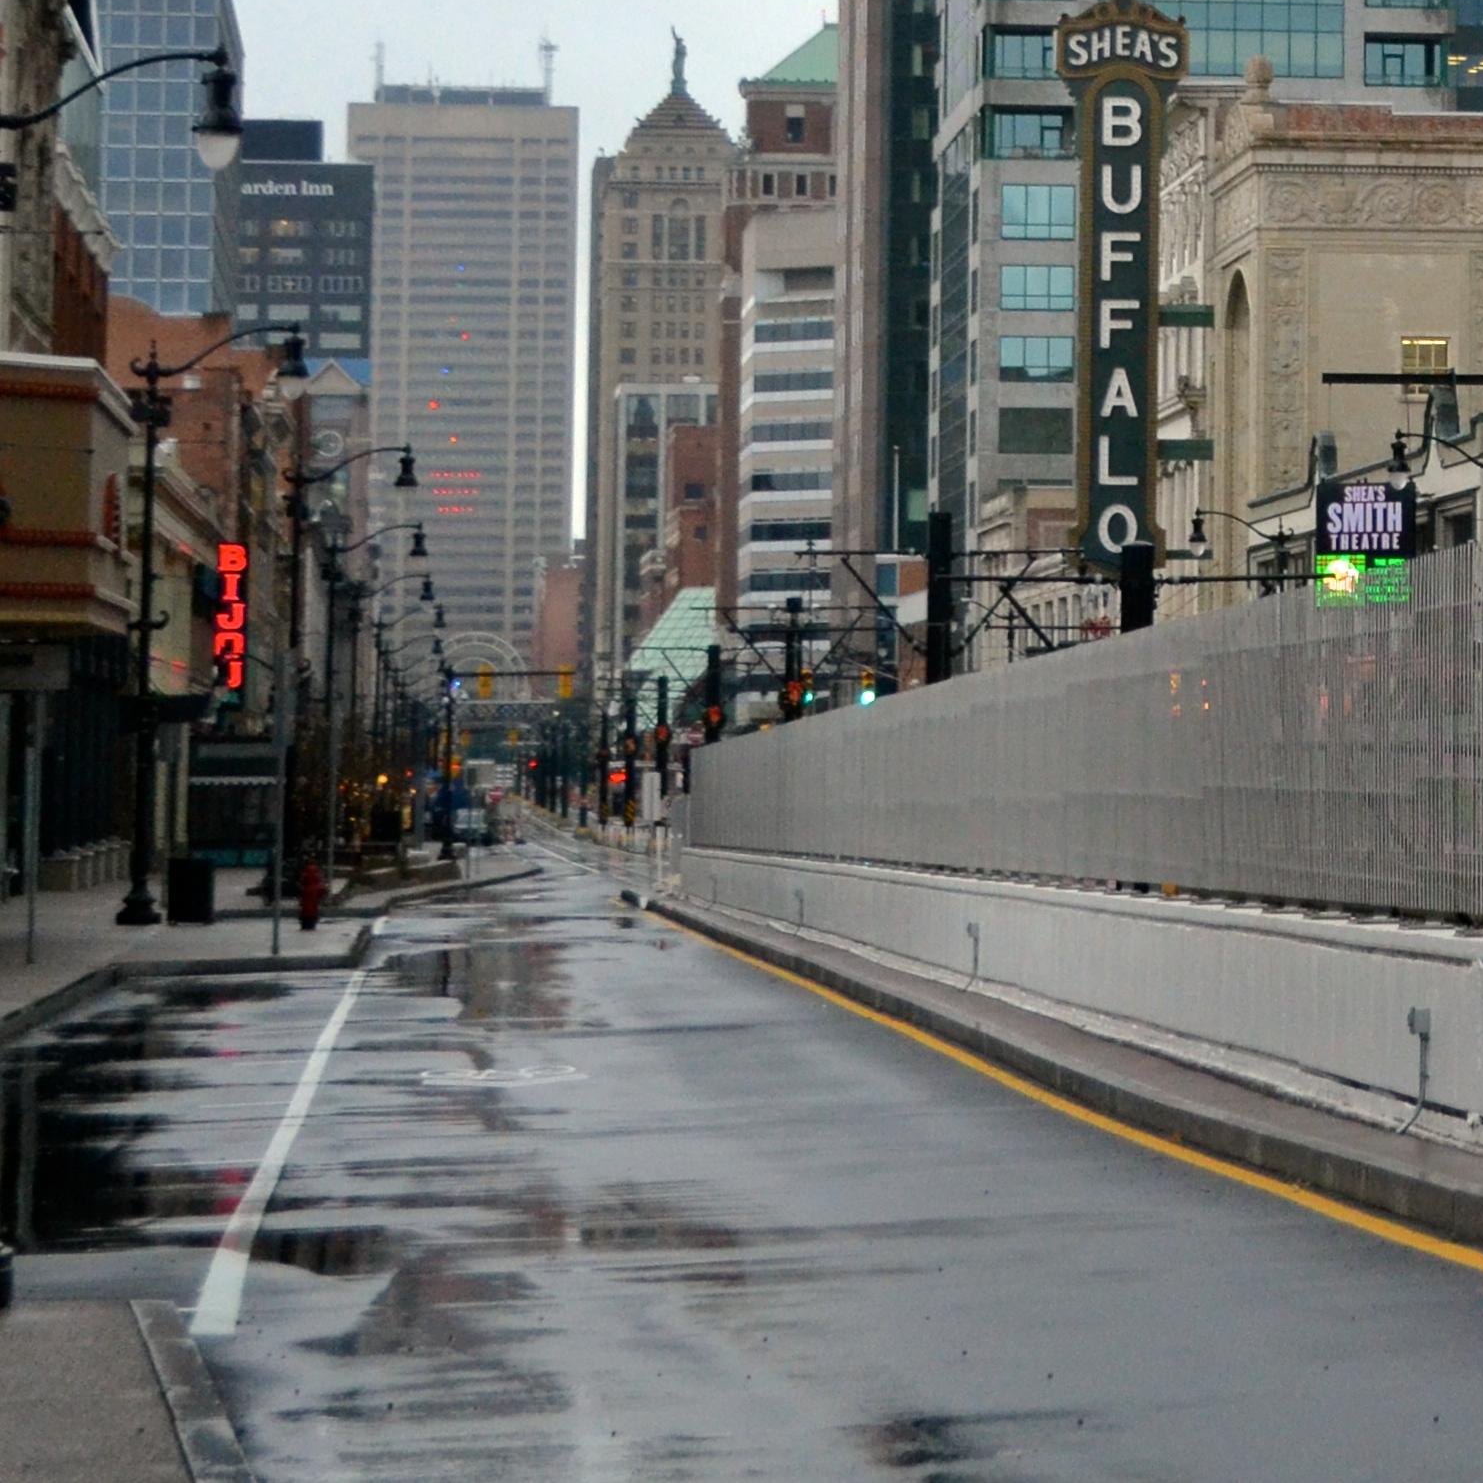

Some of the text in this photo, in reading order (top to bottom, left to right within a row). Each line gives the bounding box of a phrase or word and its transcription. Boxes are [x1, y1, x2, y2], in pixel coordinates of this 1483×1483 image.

[1068, 24, 1179, 68] SHEA'S
[300, 179, 335, 196] Inn
[1099, 96, 1143, 555] BUFFALO
[1344, 485, 1386, 503] SHEA'S
[1326, 502, 1402, 534] SMITH
[1330, 532, 1400, 551] THEATRE
